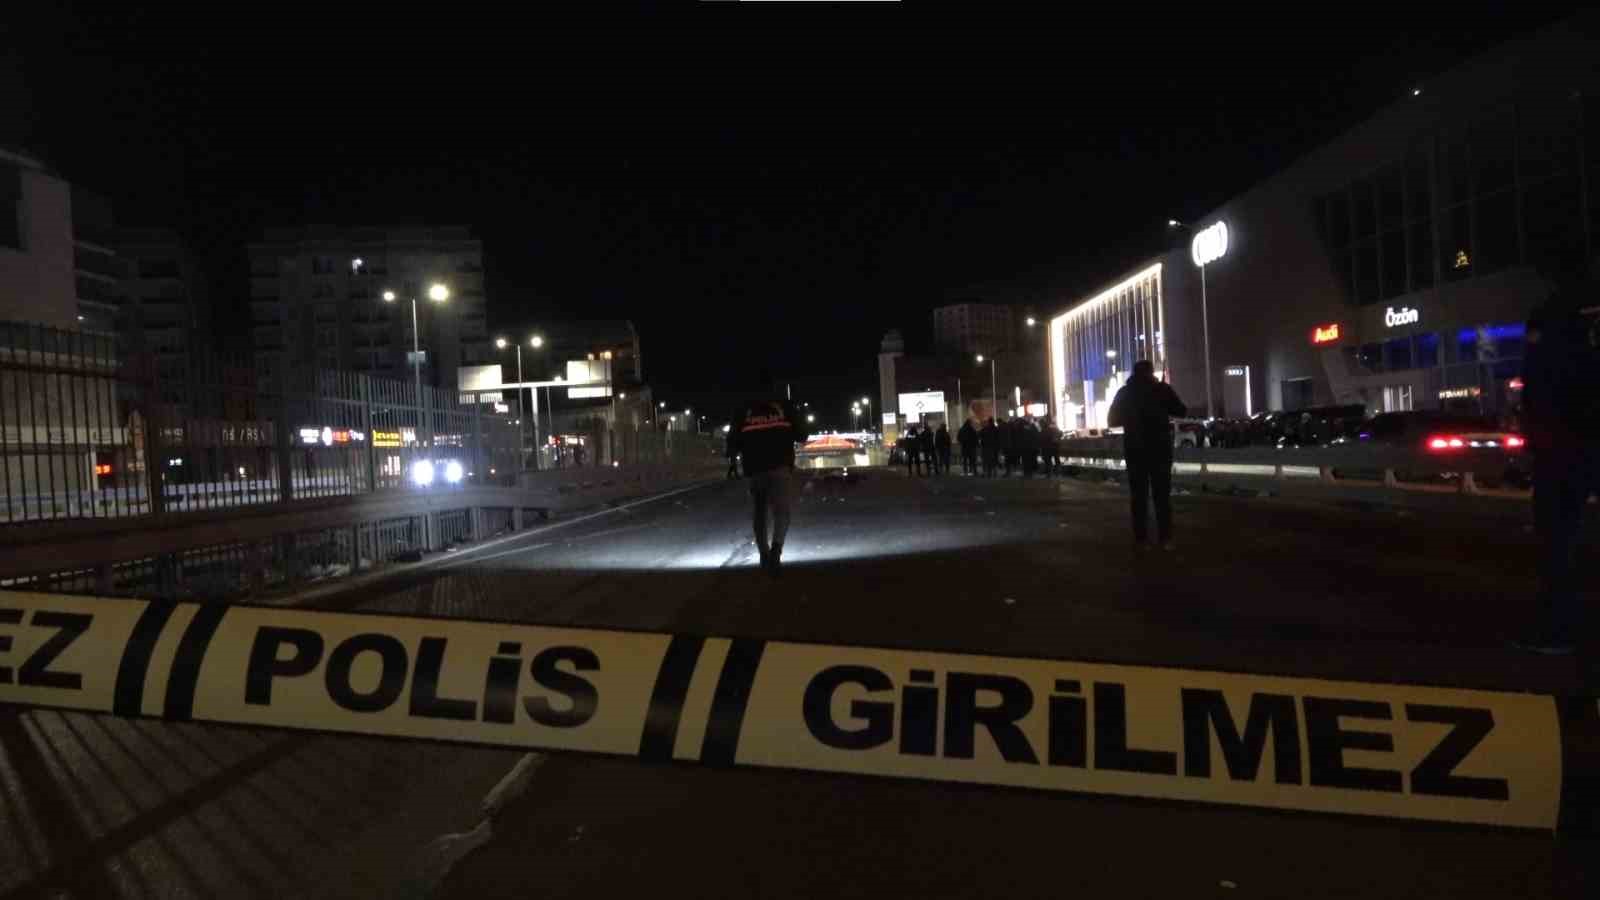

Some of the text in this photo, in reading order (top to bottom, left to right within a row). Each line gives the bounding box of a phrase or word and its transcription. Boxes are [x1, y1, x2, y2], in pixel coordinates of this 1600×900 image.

[1385, 306, 1418, 327] Özön
[1313, 324, 1339, 343] Audi
[244, 625, 601, 728] POLİS
[802, 664, 1511, 801] GİRİLMEZ
